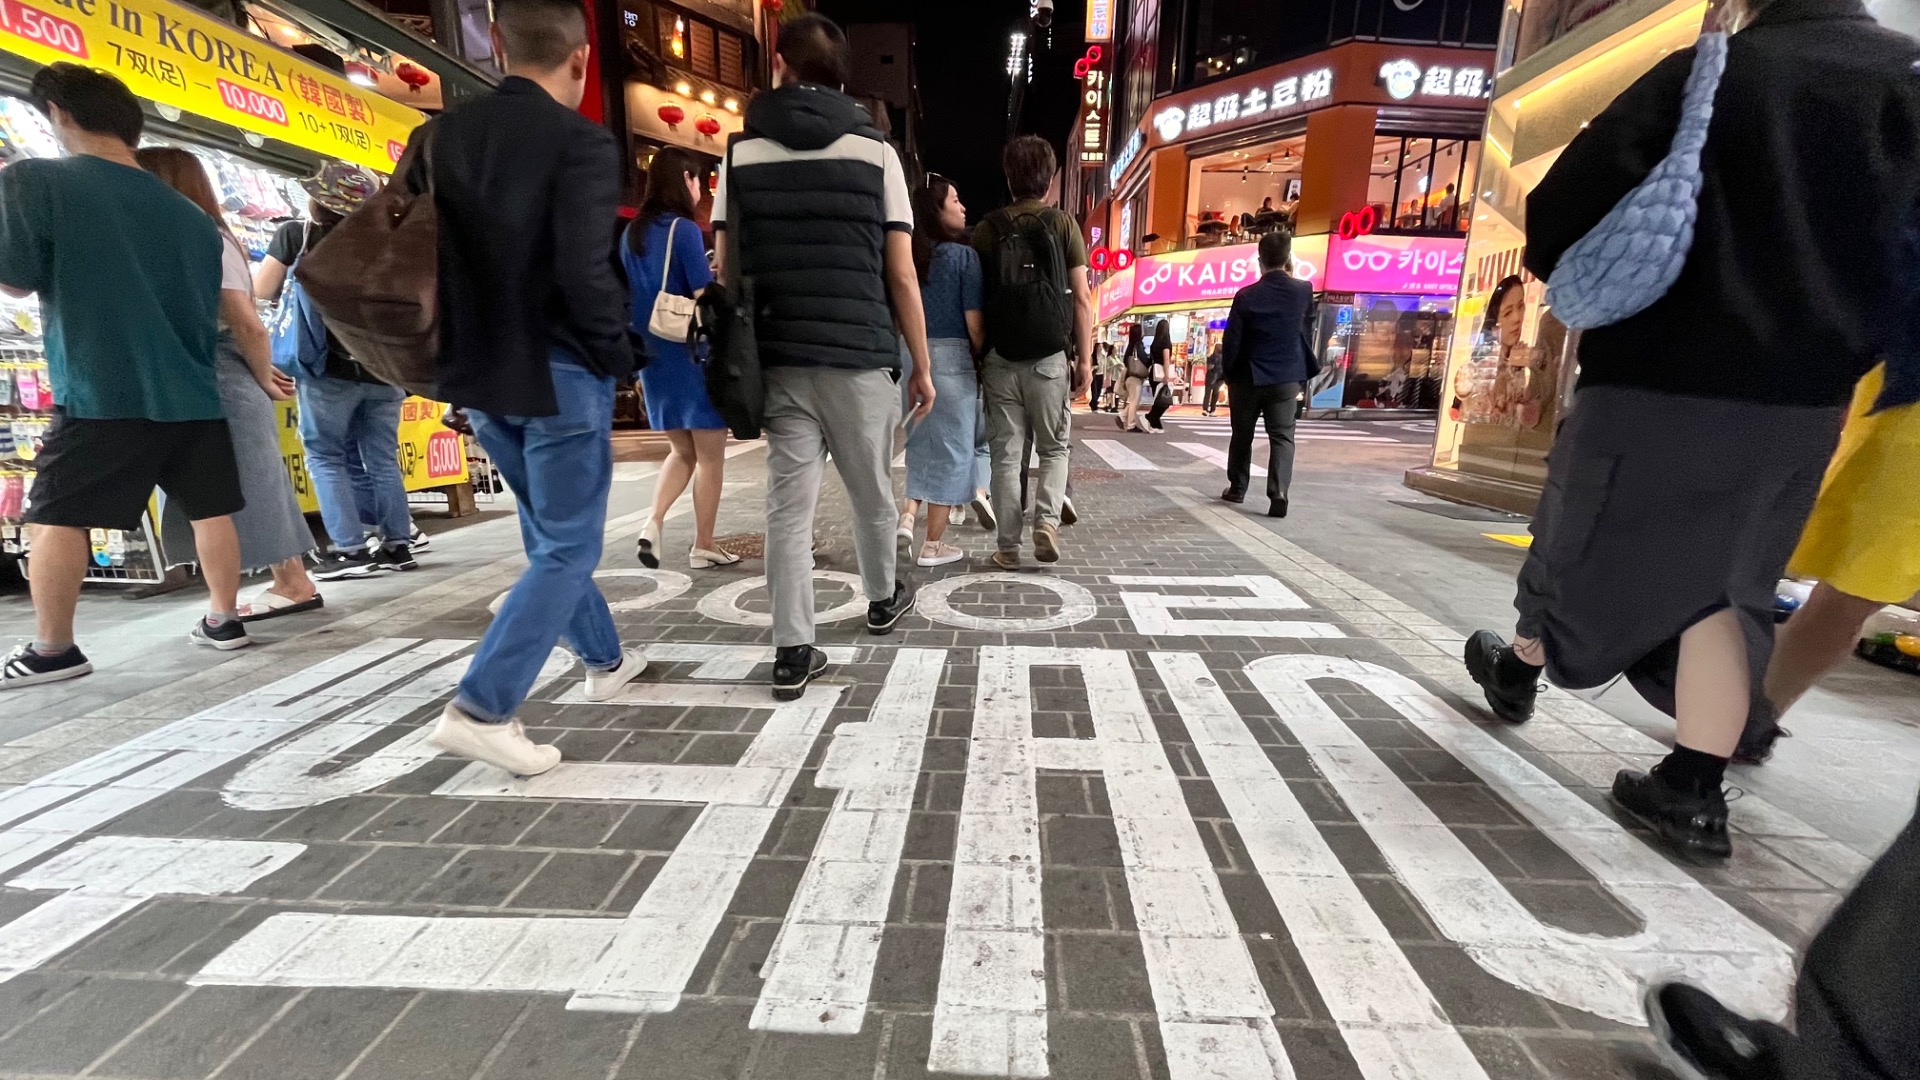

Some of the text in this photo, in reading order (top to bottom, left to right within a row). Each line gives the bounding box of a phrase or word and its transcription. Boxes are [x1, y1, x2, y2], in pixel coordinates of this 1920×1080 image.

[107, 41, 188, 92] 7双(足)
[218, 81, 286, 123] 10,000
[108, 0, 145, 38] in
[154, 11, 284, 91] KOREA
[1085, 70, 1105, 149] 카이스트
[1186, 68, 1333, 131] 超级土豆粉
[429, 436, 460, 475] 15,000
